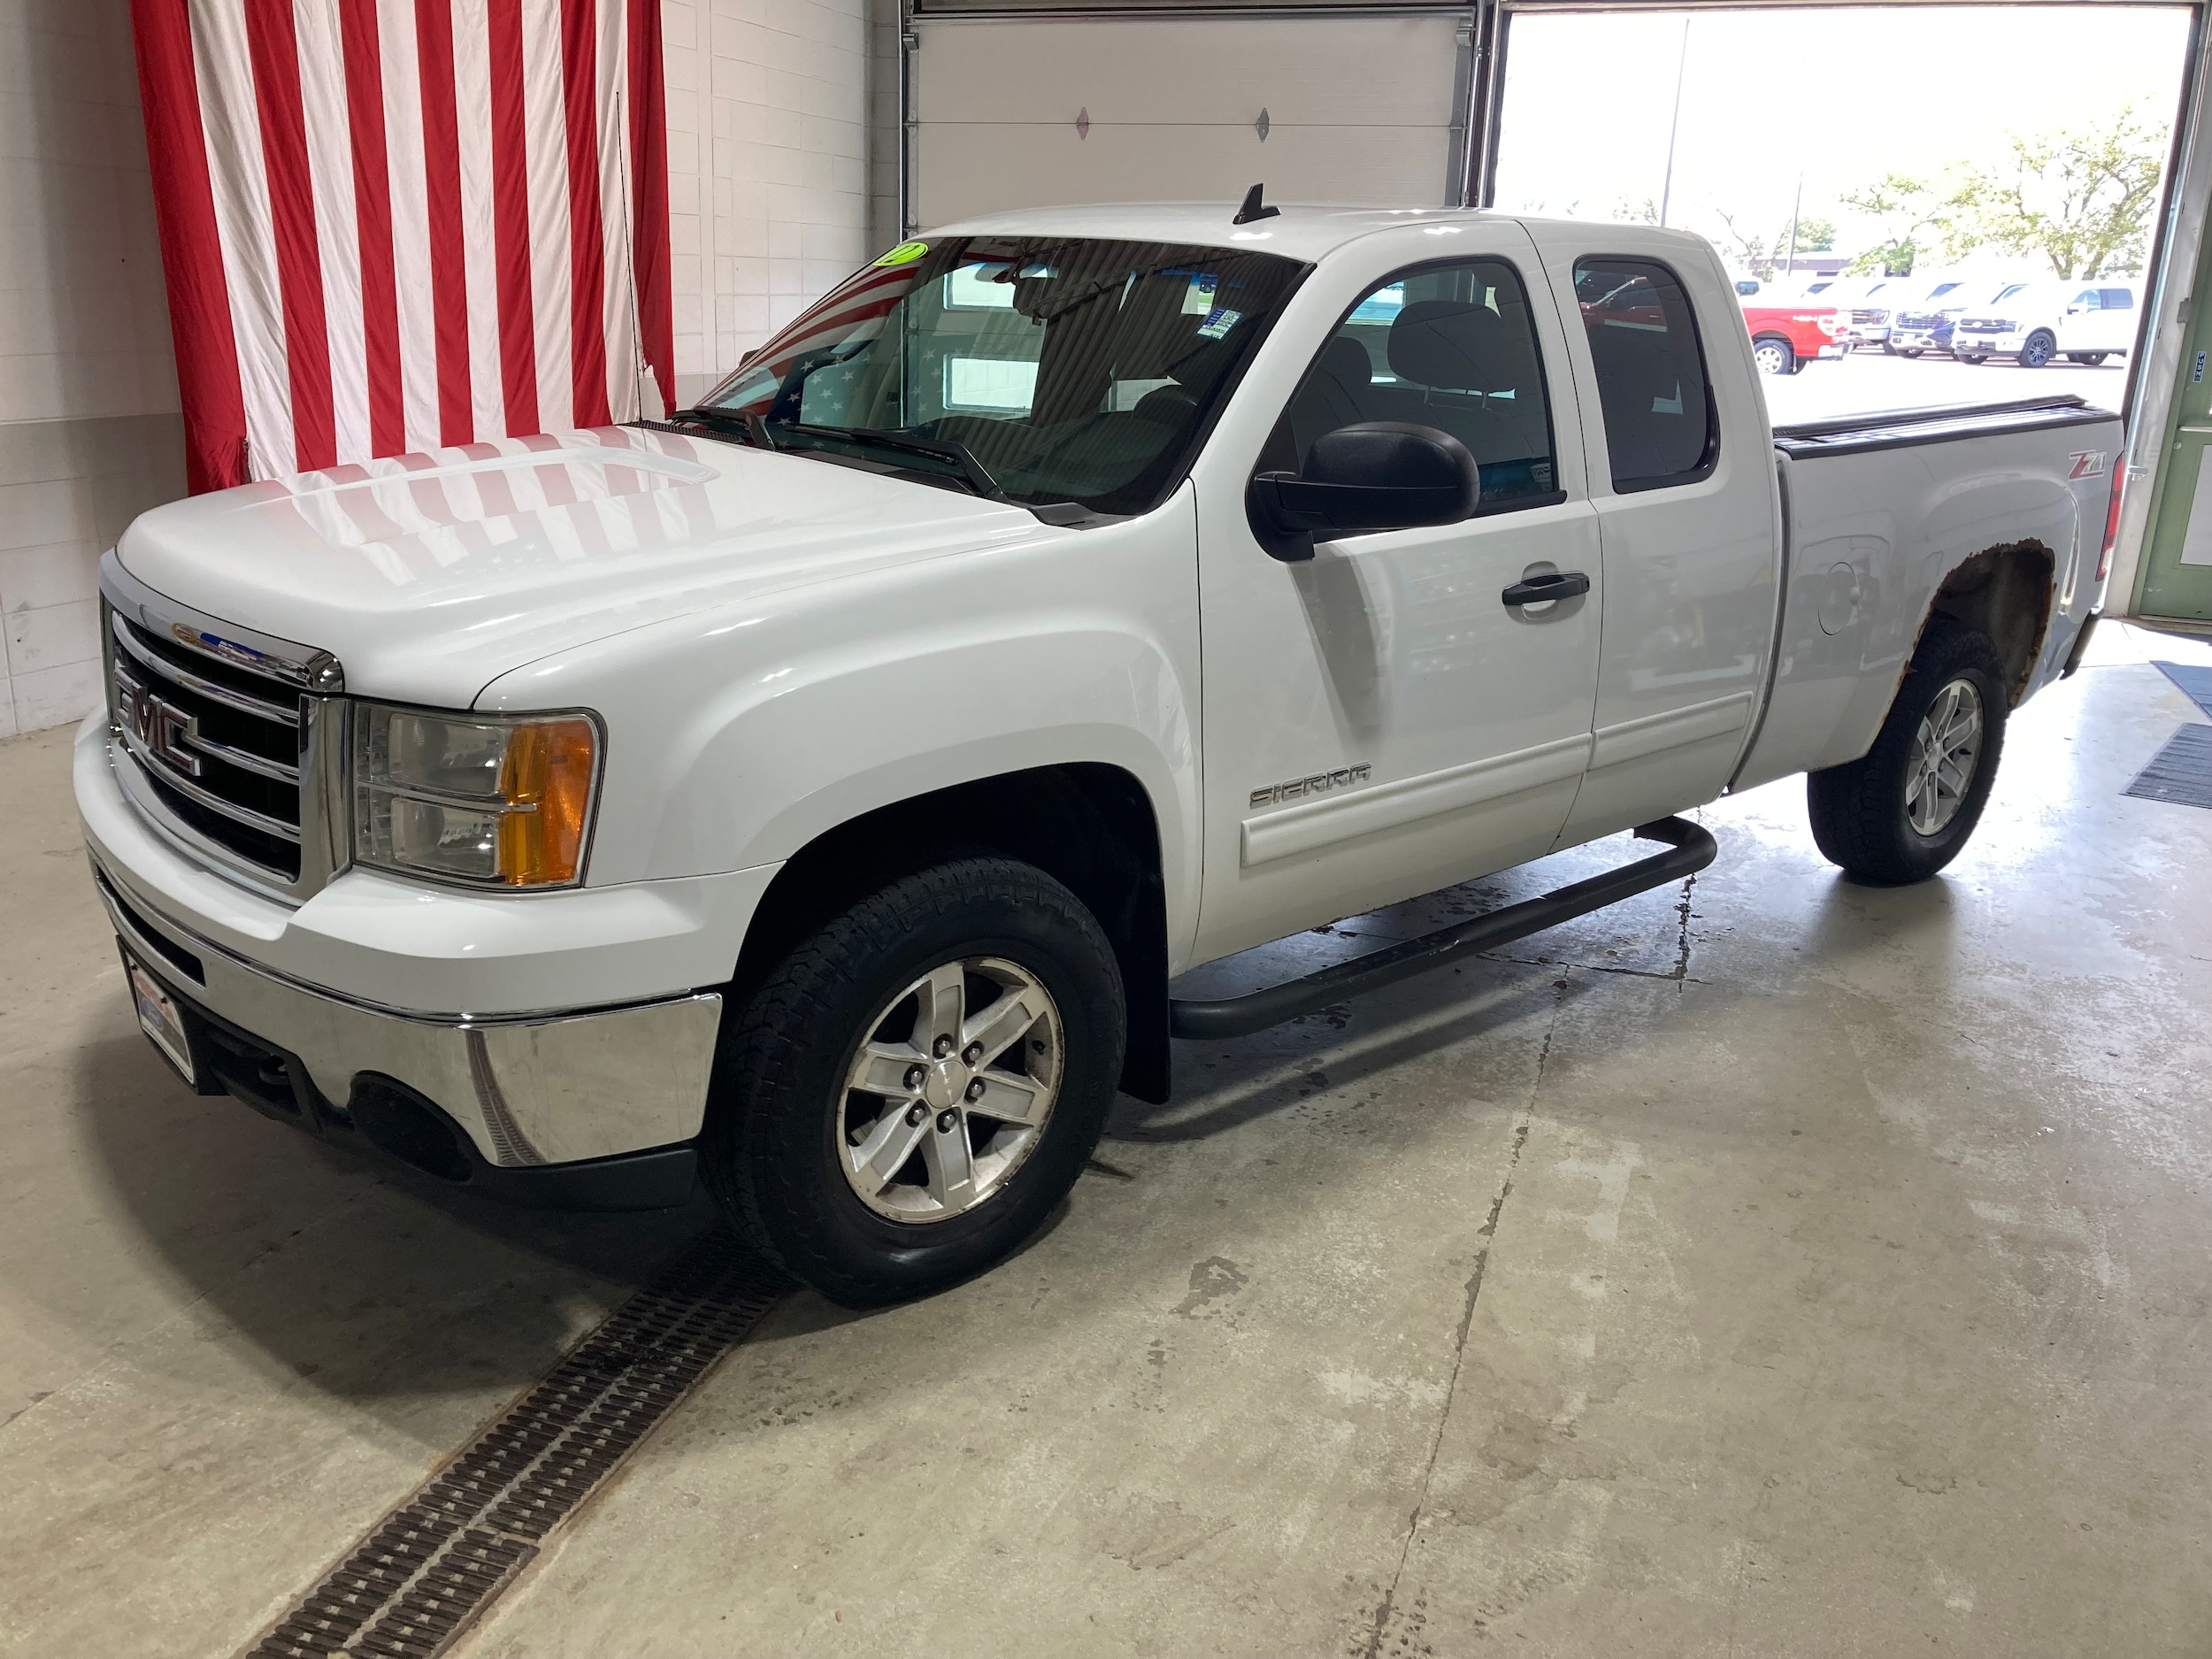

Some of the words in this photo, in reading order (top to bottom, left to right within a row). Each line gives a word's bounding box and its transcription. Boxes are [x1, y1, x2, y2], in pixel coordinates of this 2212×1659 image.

[2195, 351, 2205, 377] PUSH
[2068, 449, 2108, 482] Z71
[113, 666, 201, 776] GMC
[1249, 761, 1372, 810] SIERRA
